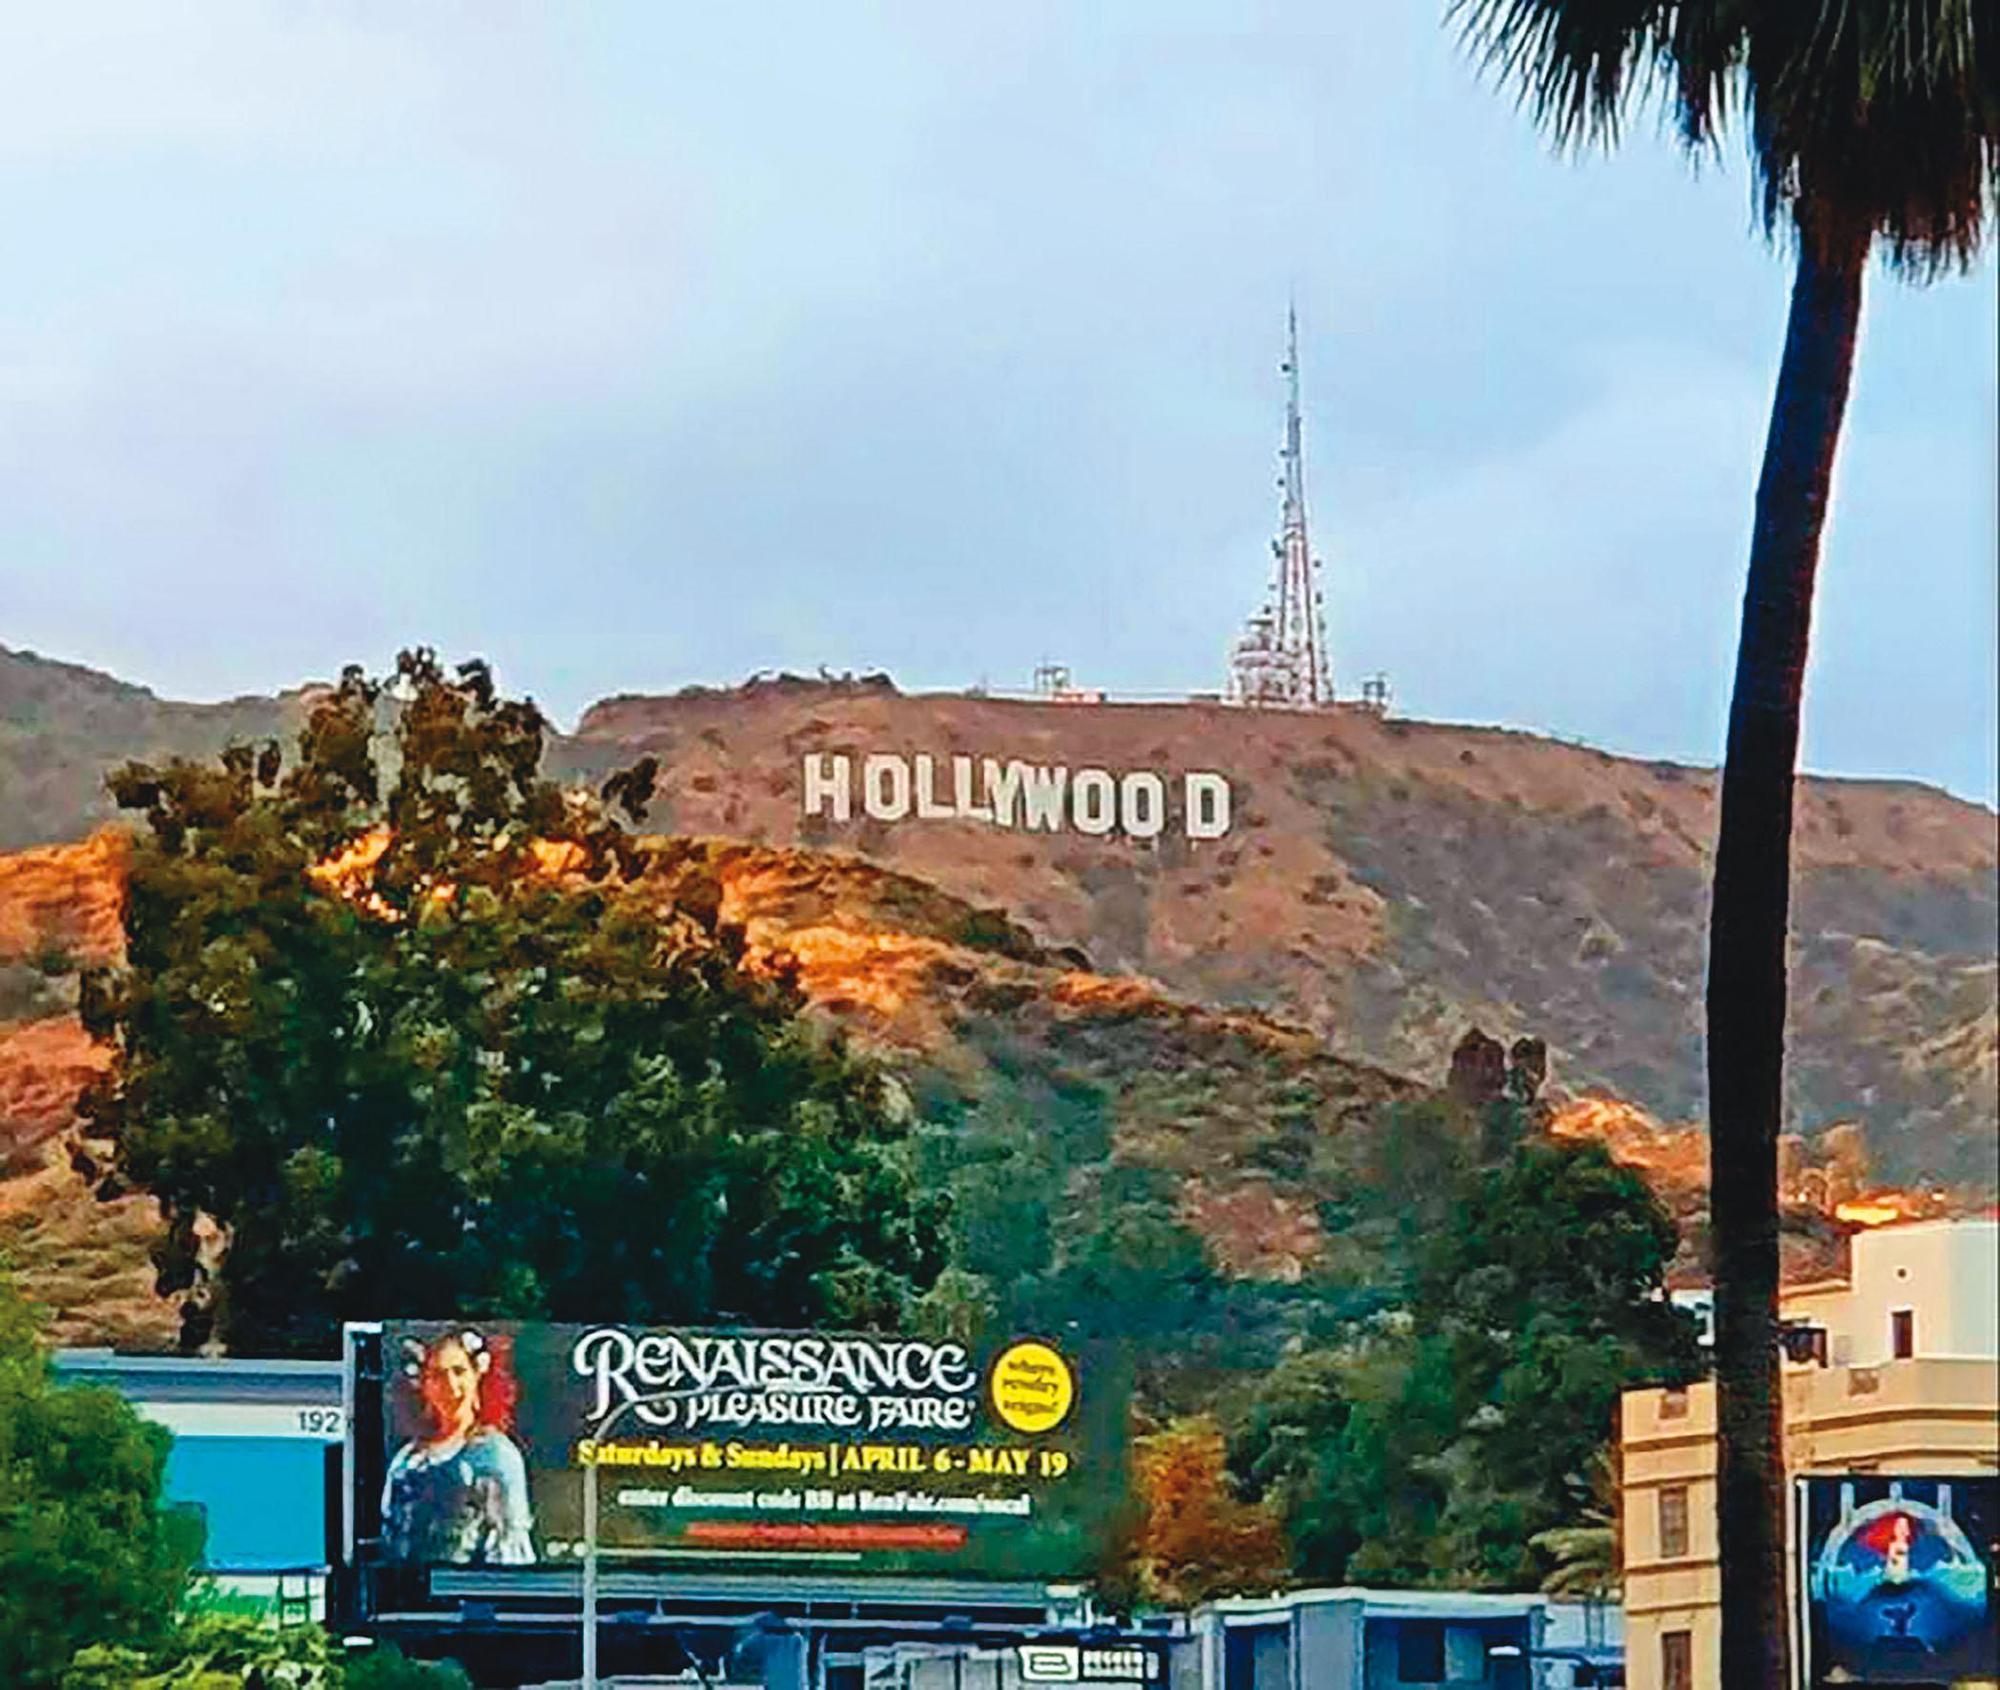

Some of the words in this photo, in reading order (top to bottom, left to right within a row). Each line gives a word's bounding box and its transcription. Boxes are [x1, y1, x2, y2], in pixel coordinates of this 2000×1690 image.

[803, 753, 1231, 839] HOLLYWOOD
[573, 1329, 977, 1425] RENAISSANCE
[685, 1392, 862, 1429] PLEASURE
[868, 1396, 972, 1432] FAIRE
[578, 1439, 697, 1473] Saturdays
[726, 1442, 827, 1476] Sundays
[841, 1445, 927, 1471] APRIL
[1040, 1451, 1068, 1477] 19
